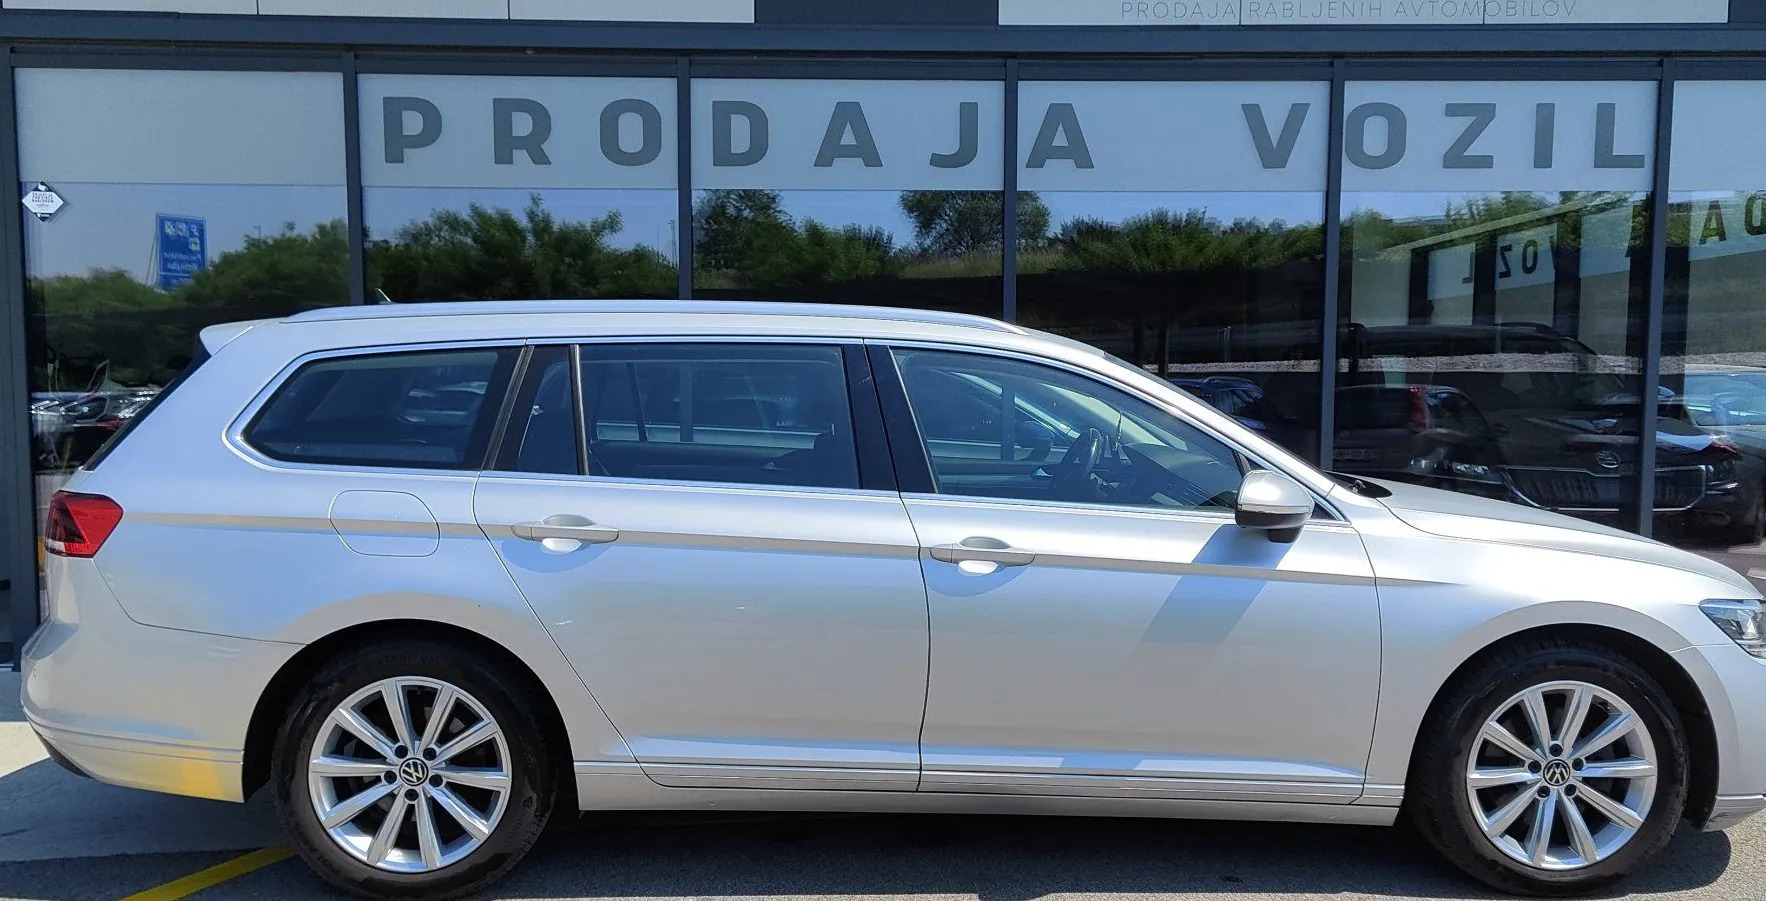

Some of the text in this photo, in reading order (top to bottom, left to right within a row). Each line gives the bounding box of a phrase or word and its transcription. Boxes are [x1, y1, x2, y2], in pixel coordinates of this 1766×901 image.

[1121, 1, 1578, 19] PRODAJA RABLJENIH AVTOMOBILOV
[382, 96, 1645, 170] PRODAJA VOZIL
